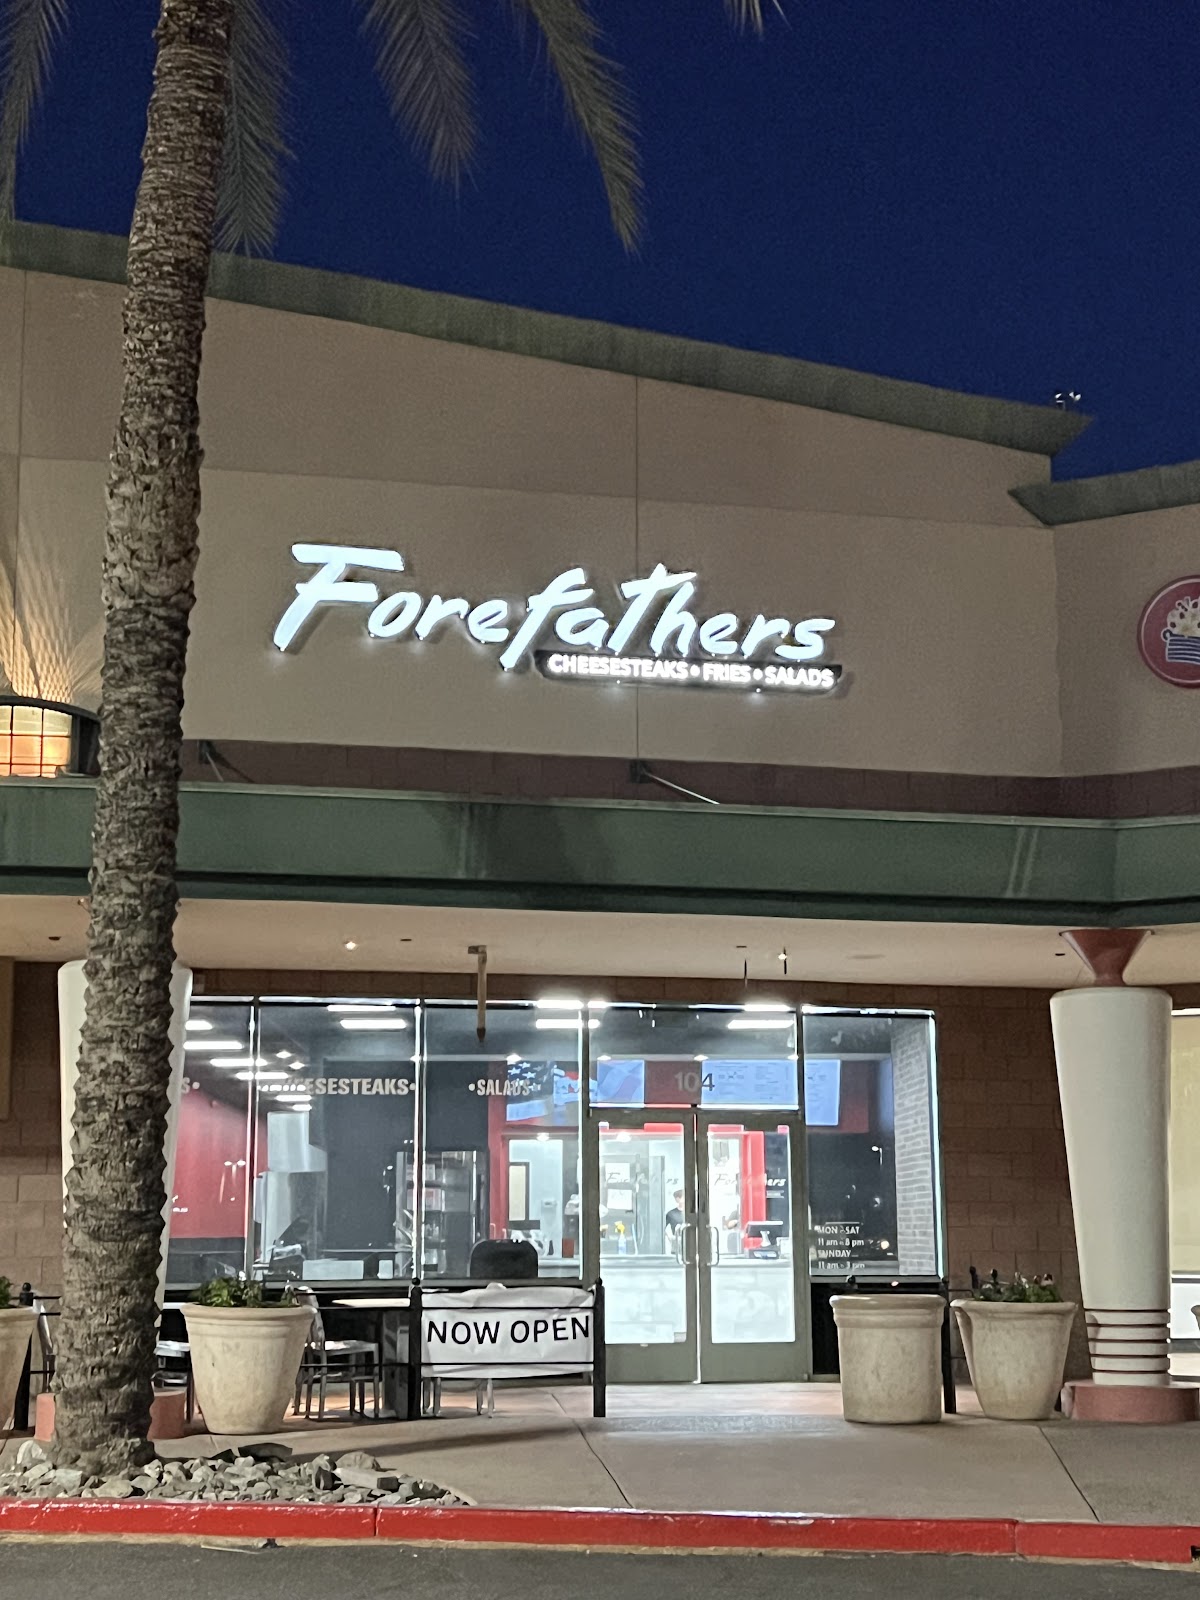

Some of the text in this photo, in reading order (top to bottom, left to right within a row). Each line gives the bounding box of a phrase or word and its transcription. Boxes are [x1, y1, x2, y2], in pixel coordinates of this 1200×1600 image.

[273, 543, 835, 669] Forefathers
[549, 654, 834, 687] CHEESESTEAKS FRIES SALADS
[477, 1079, 531, 1096] SALADS
[674, 1072, 715, 1092] 104
[817, 1226, 860, 1235] MON SAT
[852, 1239, 865, 1247] pm
[427, 1315, 589, 1345] NOW OPEN
